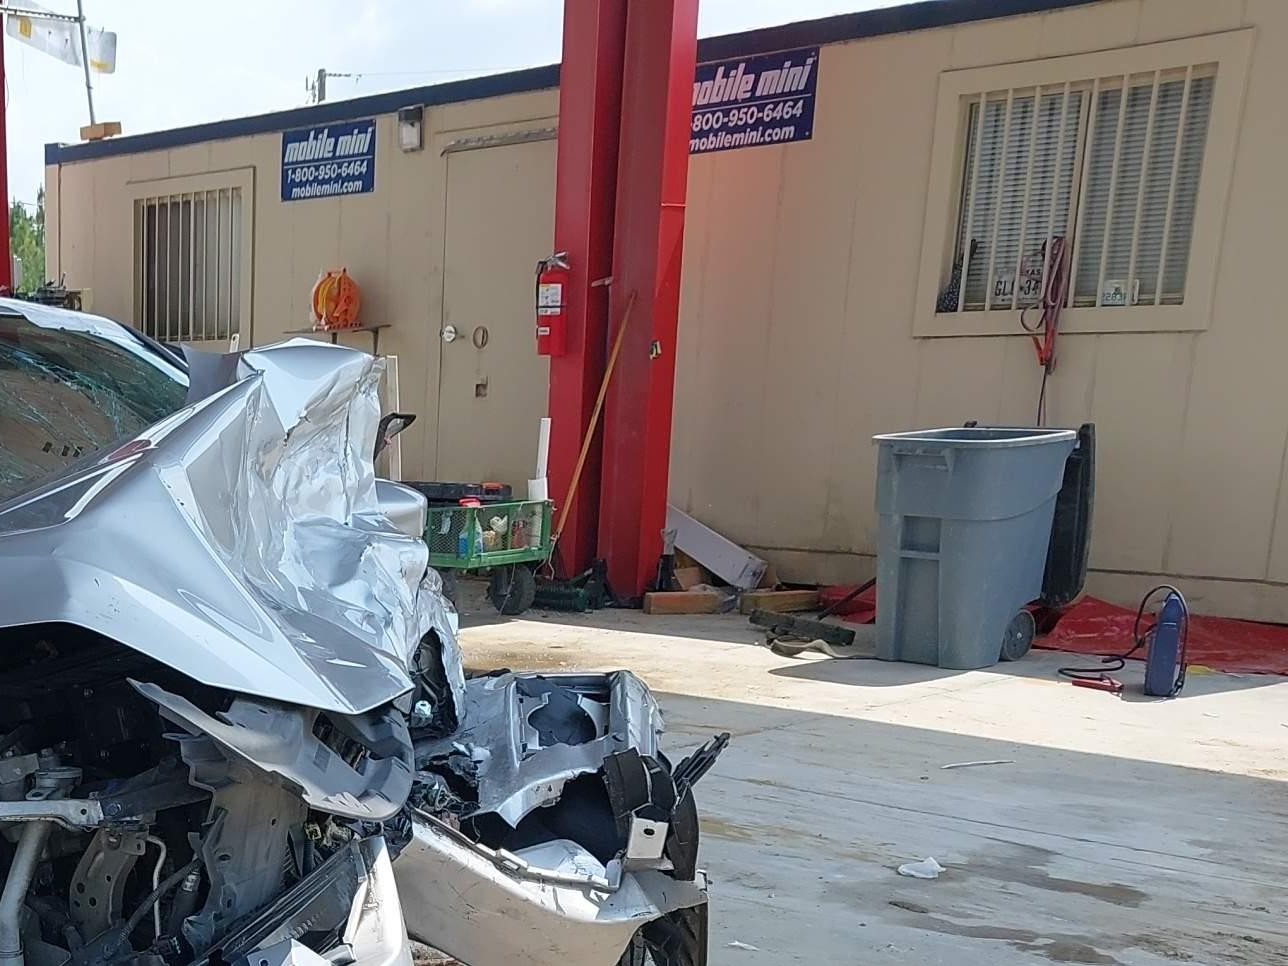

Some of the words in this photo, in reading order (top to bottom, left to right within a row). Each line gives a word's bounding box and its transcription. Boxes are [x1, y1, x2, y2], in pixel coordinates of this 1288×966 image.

[755, 60, 815, 97] mini
[284, 128, 335, 163] mobile
[335, 127, 373, 156] mini
[287, 160, 368, 183] 1-800-950-6464
[291, 180, 363, 199] mobilemini.com
